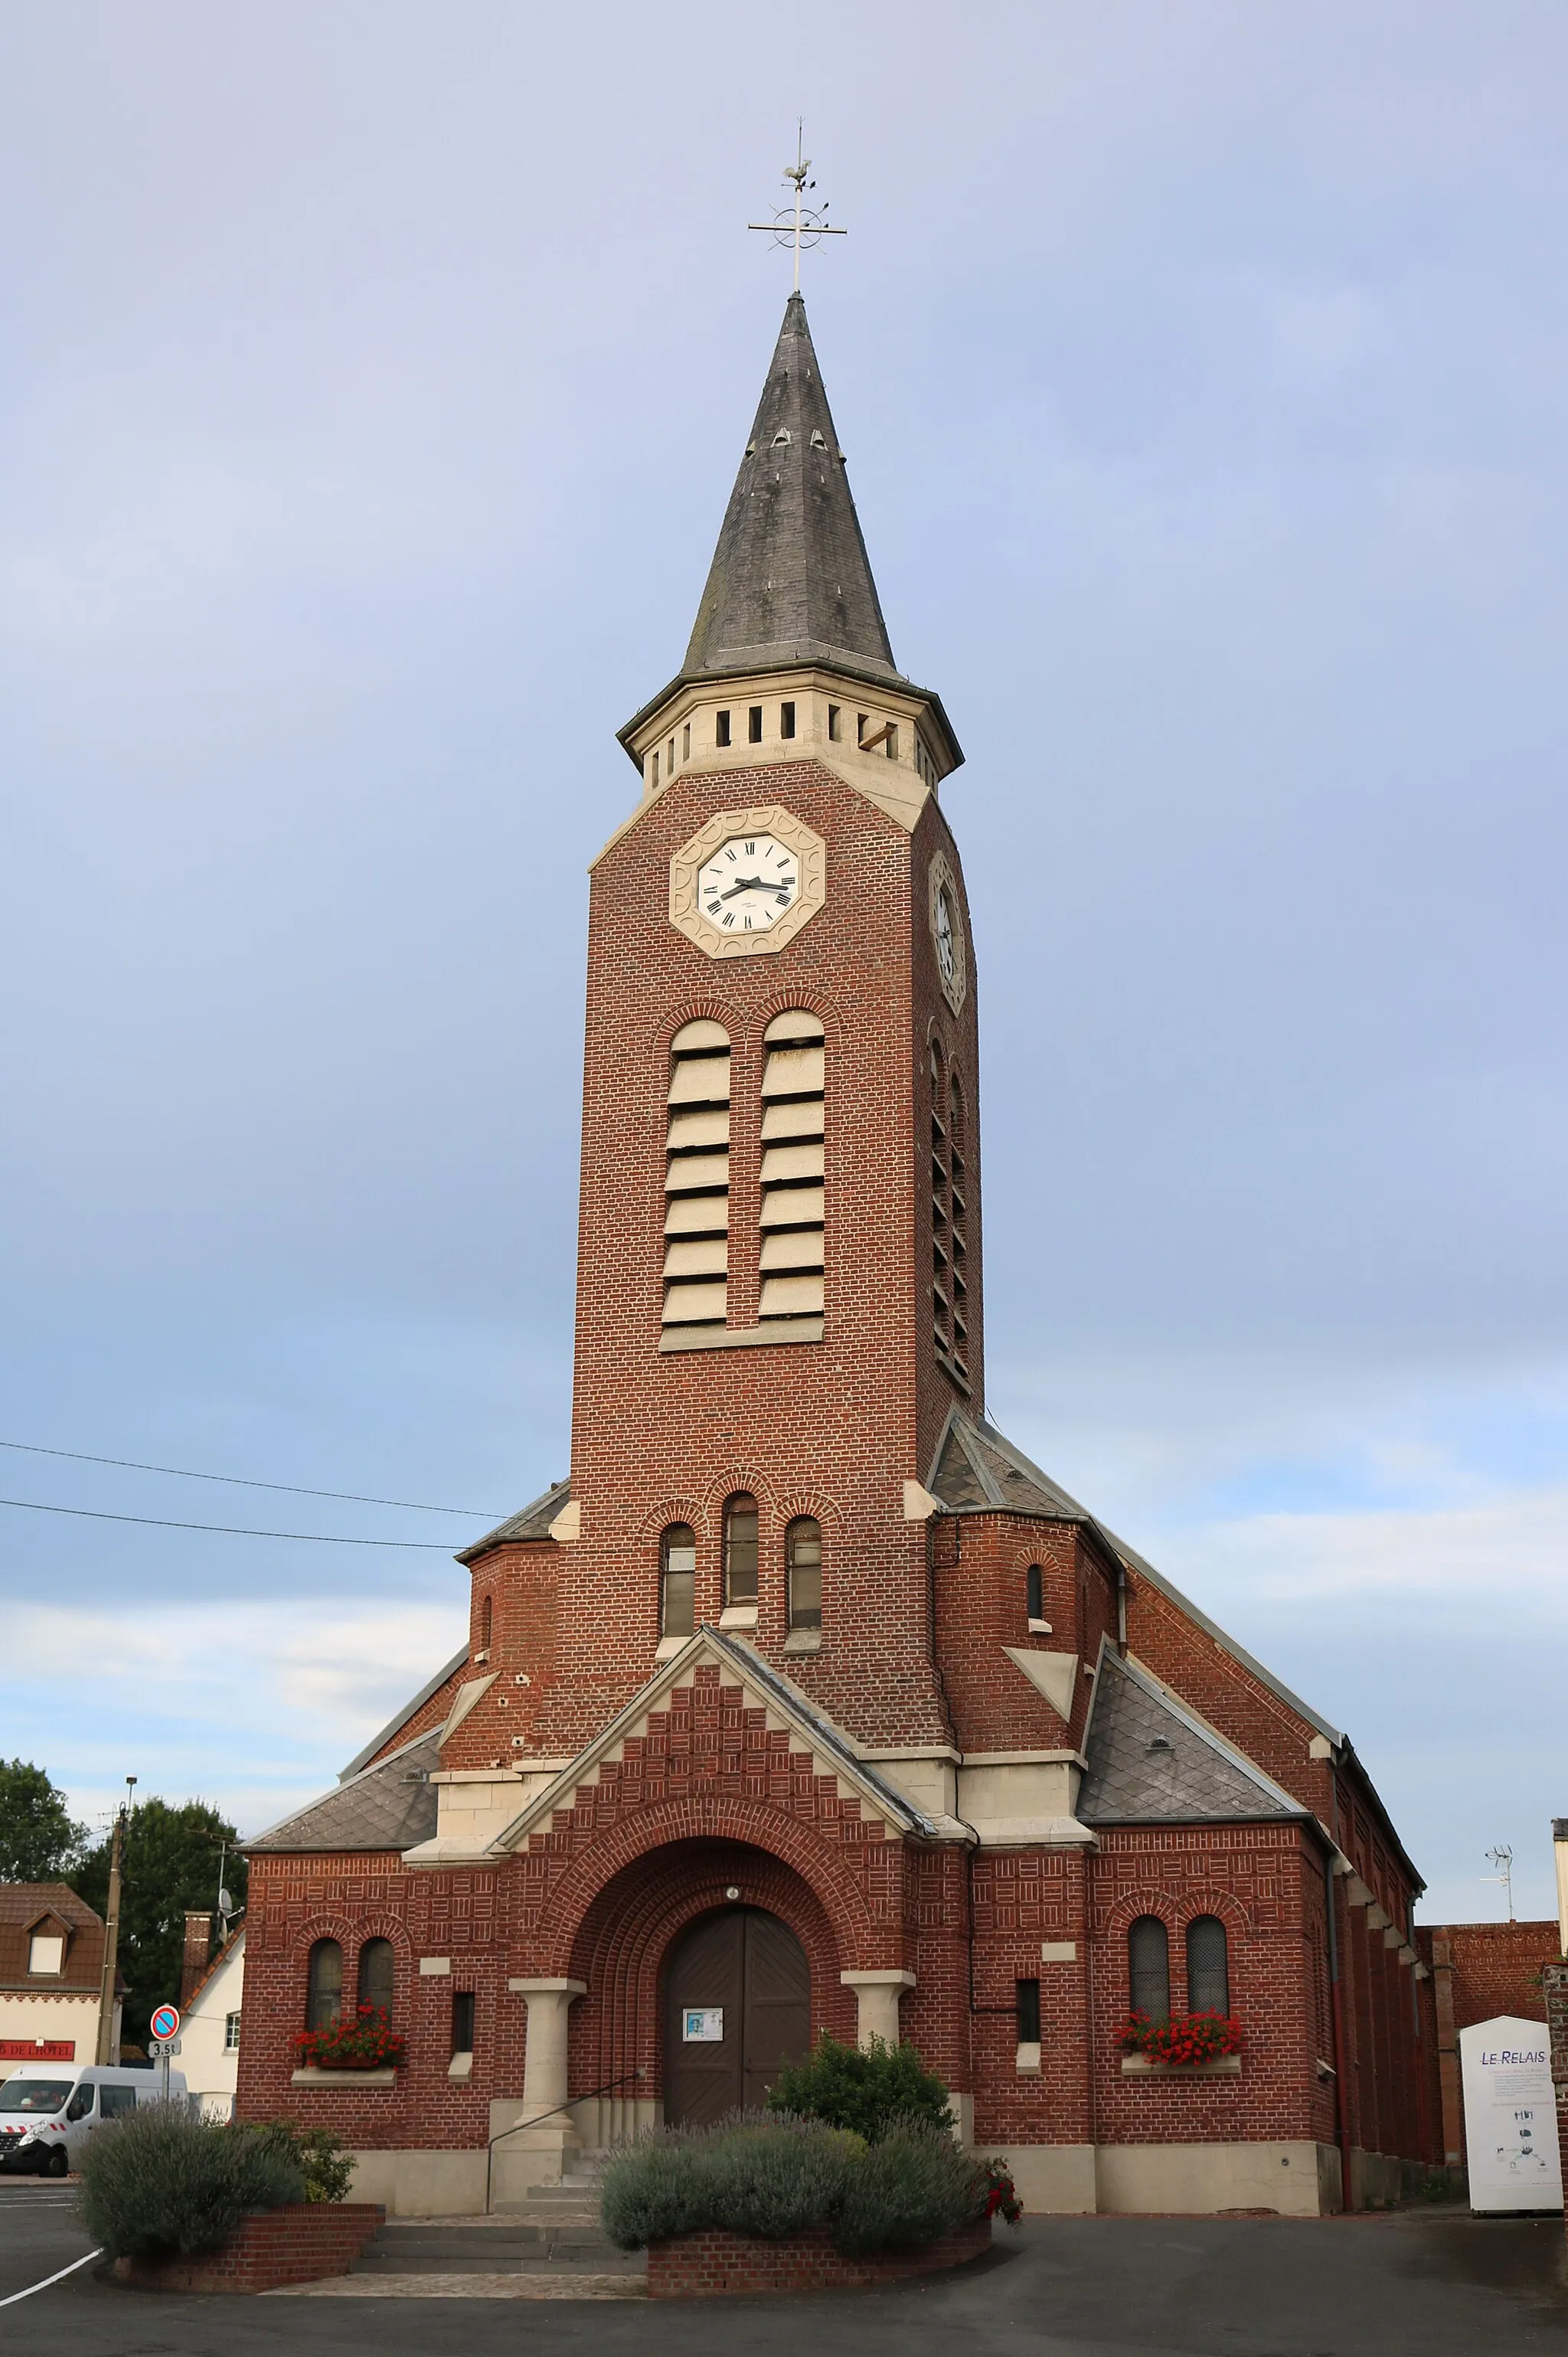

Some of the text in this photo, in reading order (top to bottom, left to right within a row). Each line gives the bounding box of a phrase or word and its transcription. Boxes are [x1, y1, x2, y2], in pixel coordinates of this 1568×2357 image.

[745, 842, 755, 855] XII
[724, 848, 737, 863] XI
[776, 858, 790, 868] II
[781, 877, 795, 885] III
[11, 2045, 25, 2055] DE
[1482, 2051, 1545, 2064] LE RELAIS
